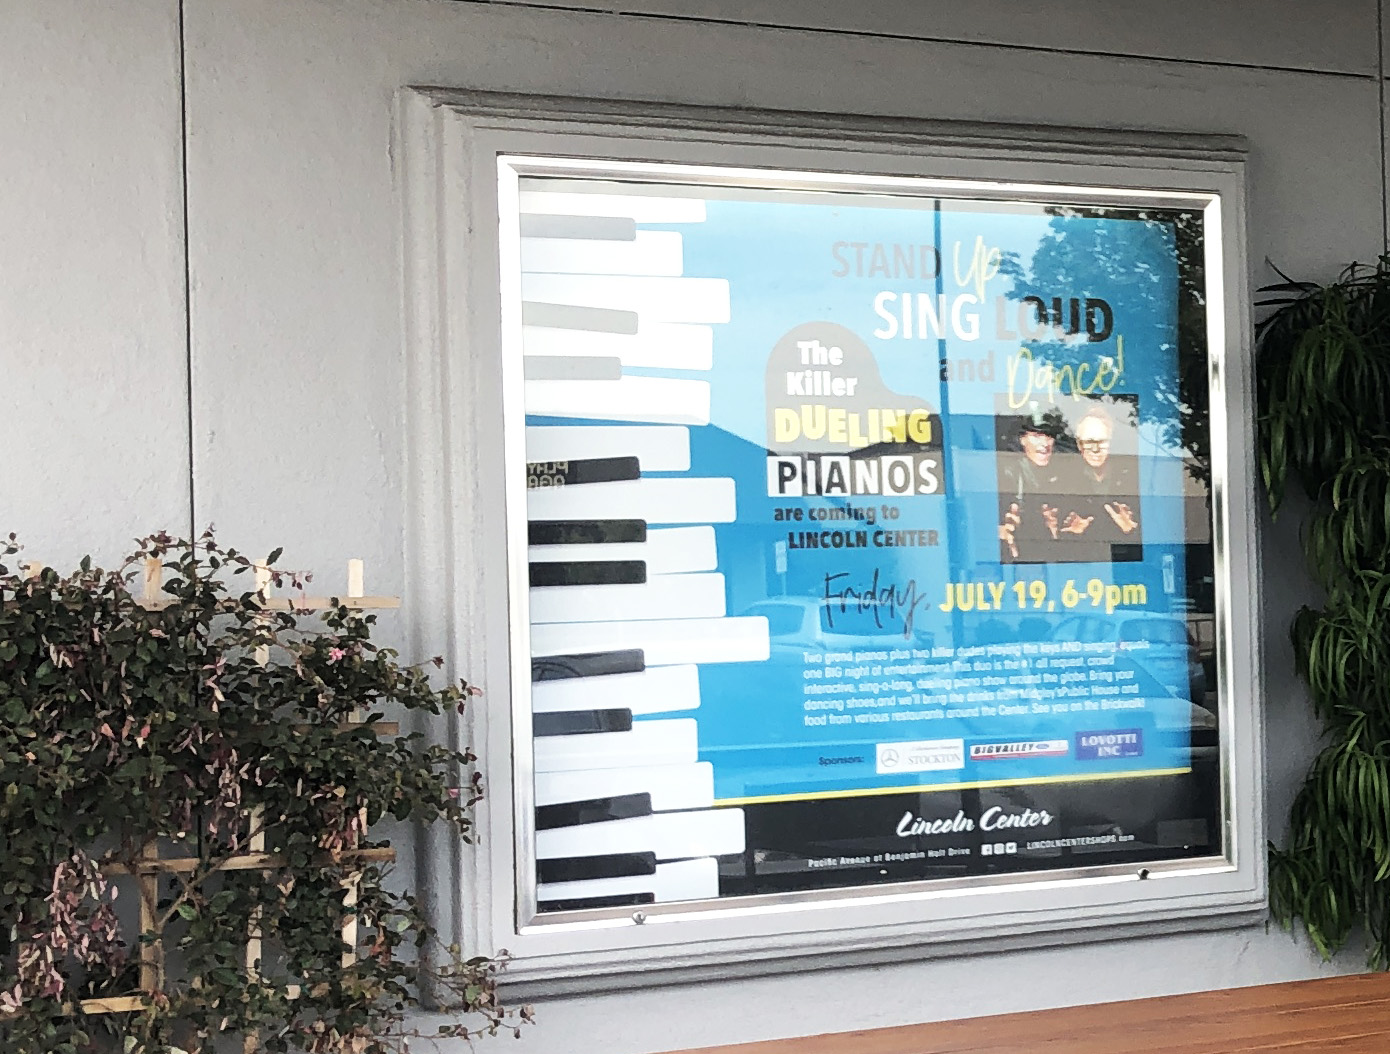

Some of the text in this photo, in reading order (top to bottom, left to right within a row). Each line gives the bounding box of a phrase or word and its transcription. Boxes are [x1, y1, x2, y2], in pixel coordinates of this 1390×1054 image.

[832, 235, 1001, 303] STAND Up
[873, 291, 1114, 343] SING LOUD
[797, 341, 843, 366] The
[786, 371, 857, 397] Killer
[939, 335, 1126, 410] and Dance!
[774, 406, 931, 446] DUELING
[775, 456, 940, 495] PIANOS
[774, 503, 900, 525] are coming to
[788, 529, 940, 550] LINCOLN CENTER
[939, 581, 1007, 613] JULY
[1013, 580, 1055, 612] 19,
[1061, 578, 1147, 614] 6-9pm
[803, 652, 822, 663] Two
[825, 652, 852, 664] grand
[856, 651, 888, 663] pianos
[890, 650, 910, 661] plus
[913, 650, 930, 658] two
[1024, 643, 1038, 653] the
[1041, 643, 1060, 654] keys
[1062, 642, 1081, 652] AND
[803, 669, 822, 679] one
[825, 667, 842, 677] BIG
[845, 666, 869, 679] night
[872, 665, 881, 675] of
[974, 661, 992, 670] duo
[994, 660, 1002, 669] is
[1004, 660, 1019, 669] the
[983, 677, 1006, 685] show
[1009, 675, 1041, 684] around
[1043, 673, 1058, 682] the
[1090, 670, 1112, 682] Bring
[1115, 671, 1134, 680] your
[804, 699, 844, 711] dancing
[949, 693, 964, 702] the
[1092, 685, 1119, 695] House
[1122, 683, 1139, 693] and
[804, 715, 826, 726] food
[829, 715, 852, 724] from
[855, 713, 889, 723] various
[892, 709, 944, 721] restaurants
[982, 706, 996, 716] the
[1032, 703, 1050, 713] See
[1052, 704, 1068, 714] you
[1071, 703, 1082, 711] on
[1085, 701, 1098, 710] the
[1097, 745, 1120, 757] INC
[896, 805, 1055, 837] Lincoln Center
[948, 847, 971, 857] Drive
